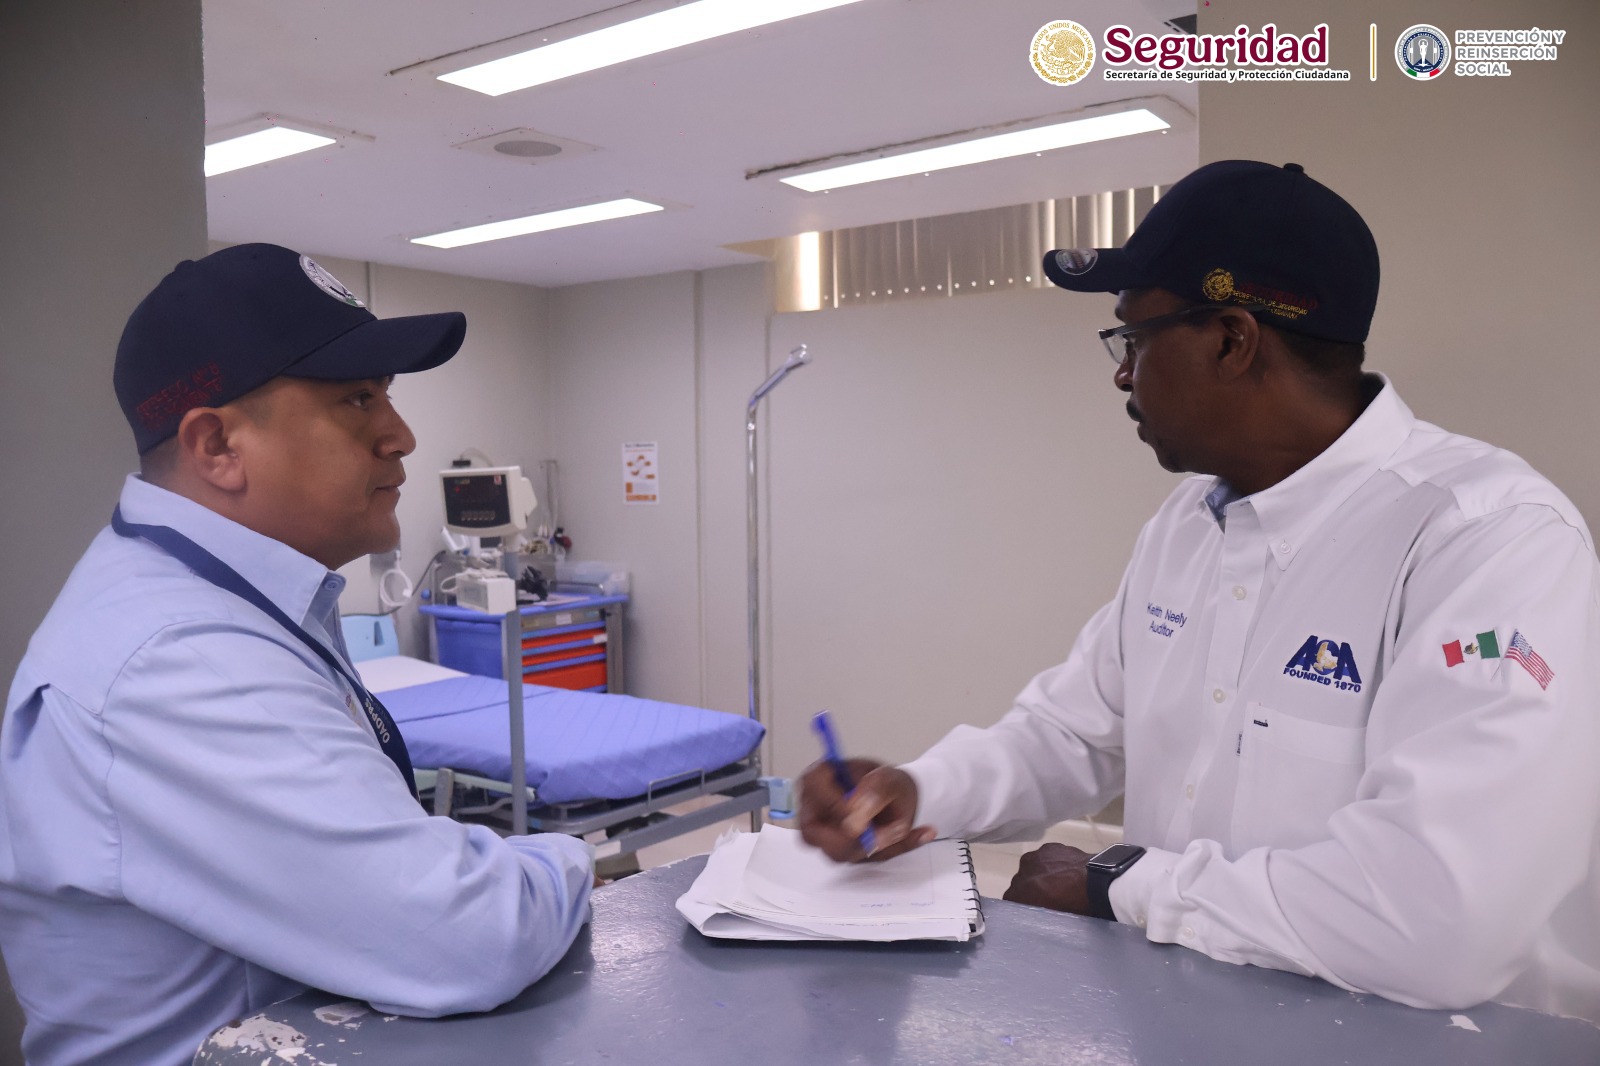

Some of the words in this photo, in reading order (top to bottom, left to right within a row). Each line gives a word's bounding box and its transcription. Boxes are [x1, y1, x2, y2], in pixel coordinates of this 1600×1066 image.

[1147, 602, 1163, 618] Keith
[1165, 609, 1188, 628] Neely
[1149, 620, 1174, 638] Auditor
[1283, 667, 1332, 686] FOUNDED
[1334, 680, 1362, 693] 1870
